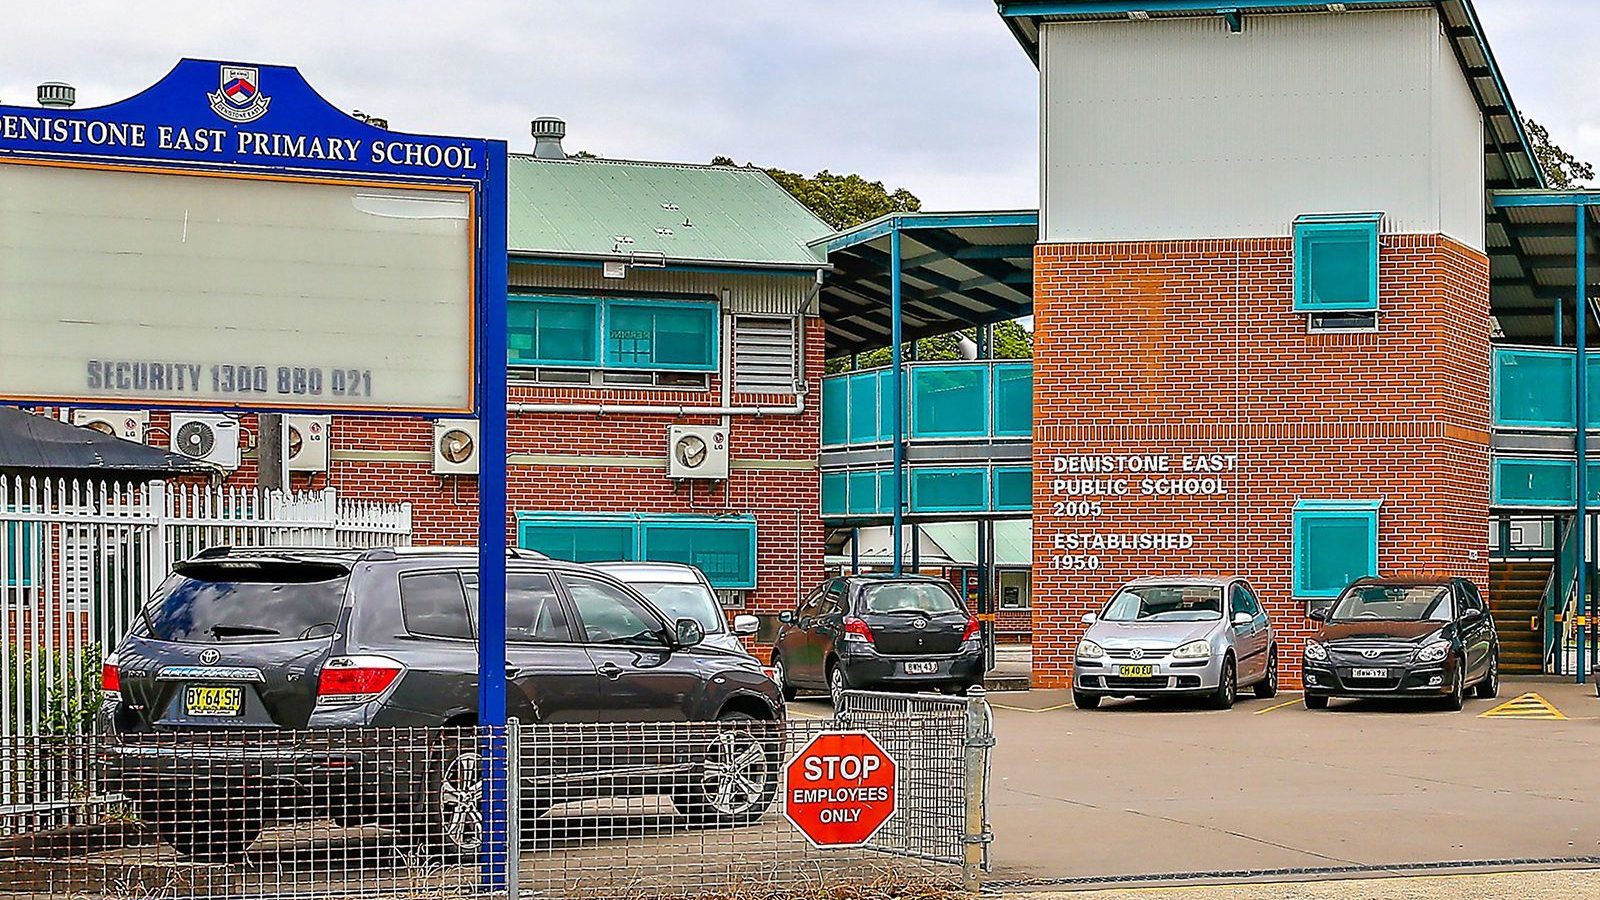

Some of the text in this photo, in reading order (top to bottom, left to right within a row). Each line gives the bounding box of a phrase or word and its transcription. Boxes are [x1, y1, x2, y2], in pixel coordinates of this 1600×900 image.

[0, 115, 477, 169] ENISTONE EAST PRIMARY SCHOOL
[87, 360, 201, 392] SECURITY
[211, 365, 268, 393] 1300
[331, 369, 372, 397] 021
[1053, 455, 1237, 473] DENISTONE EAST
[1053, 478, 1228, 495] PUBLIC SCHOOL
[1053, 501, 1102, 517] 2005
[1053, 533, 1194, 550] ESTABLISHED
[1052, 555, 1100, 571] 1950
[804, 755, 881, 781] STOP
[793, 787, 888, 803] EMPLOYEES
[820, 808, 861, 823] ONLY
